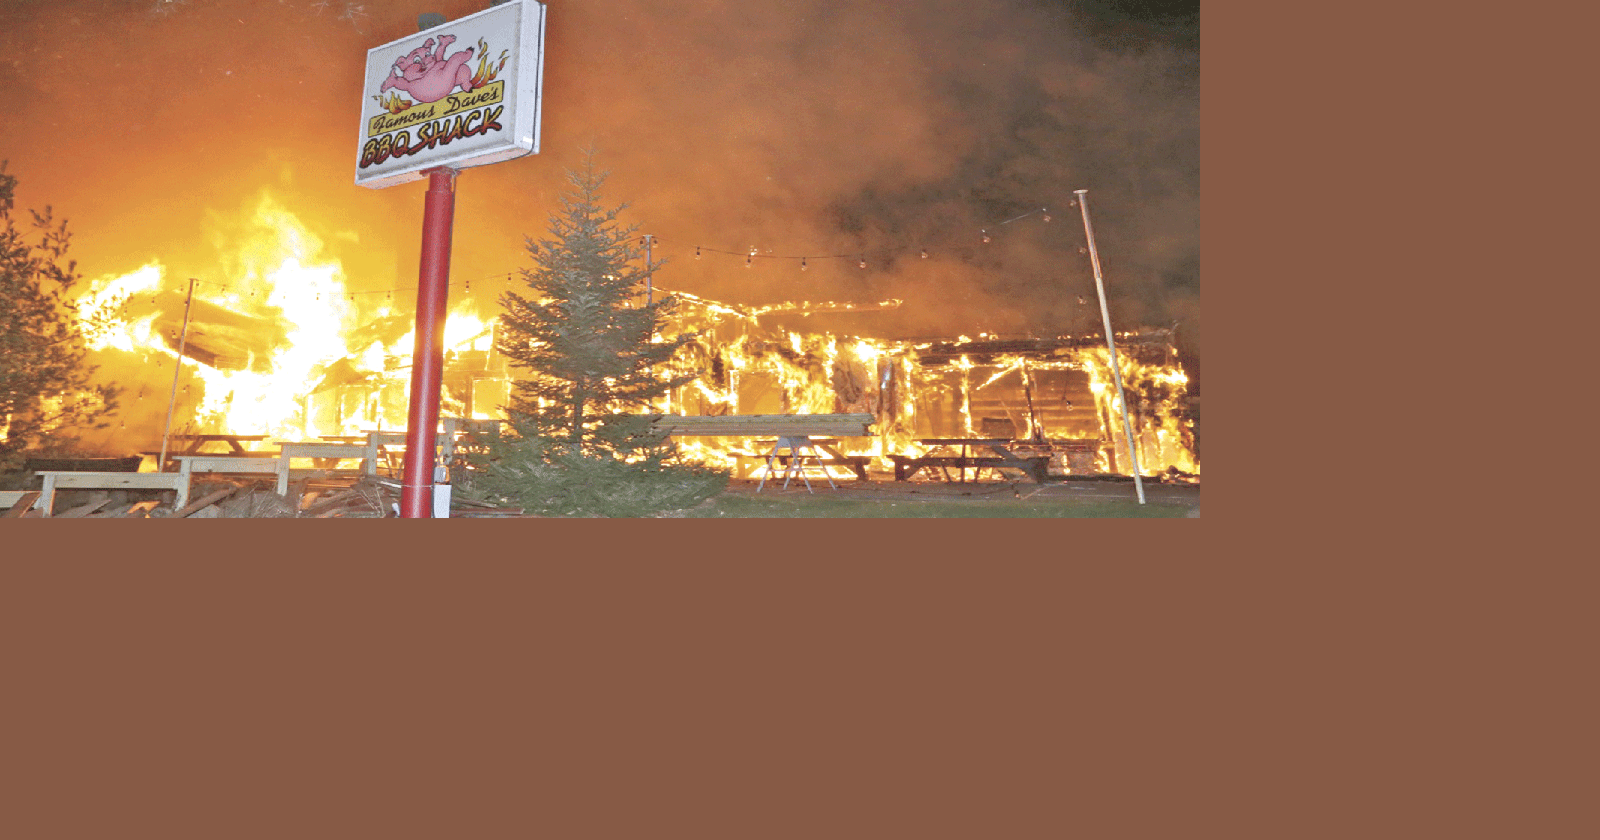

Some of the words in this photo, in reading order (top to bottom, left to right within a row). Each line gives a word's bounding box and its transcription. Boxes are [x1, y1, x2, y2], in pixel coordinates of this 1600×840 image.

[359, 130, 413, 168] BBQ
[412, 104, 504, 150] SHACK
[373, 105, 435, 132] Famous
[443, 87, 499, 115] Dave's
